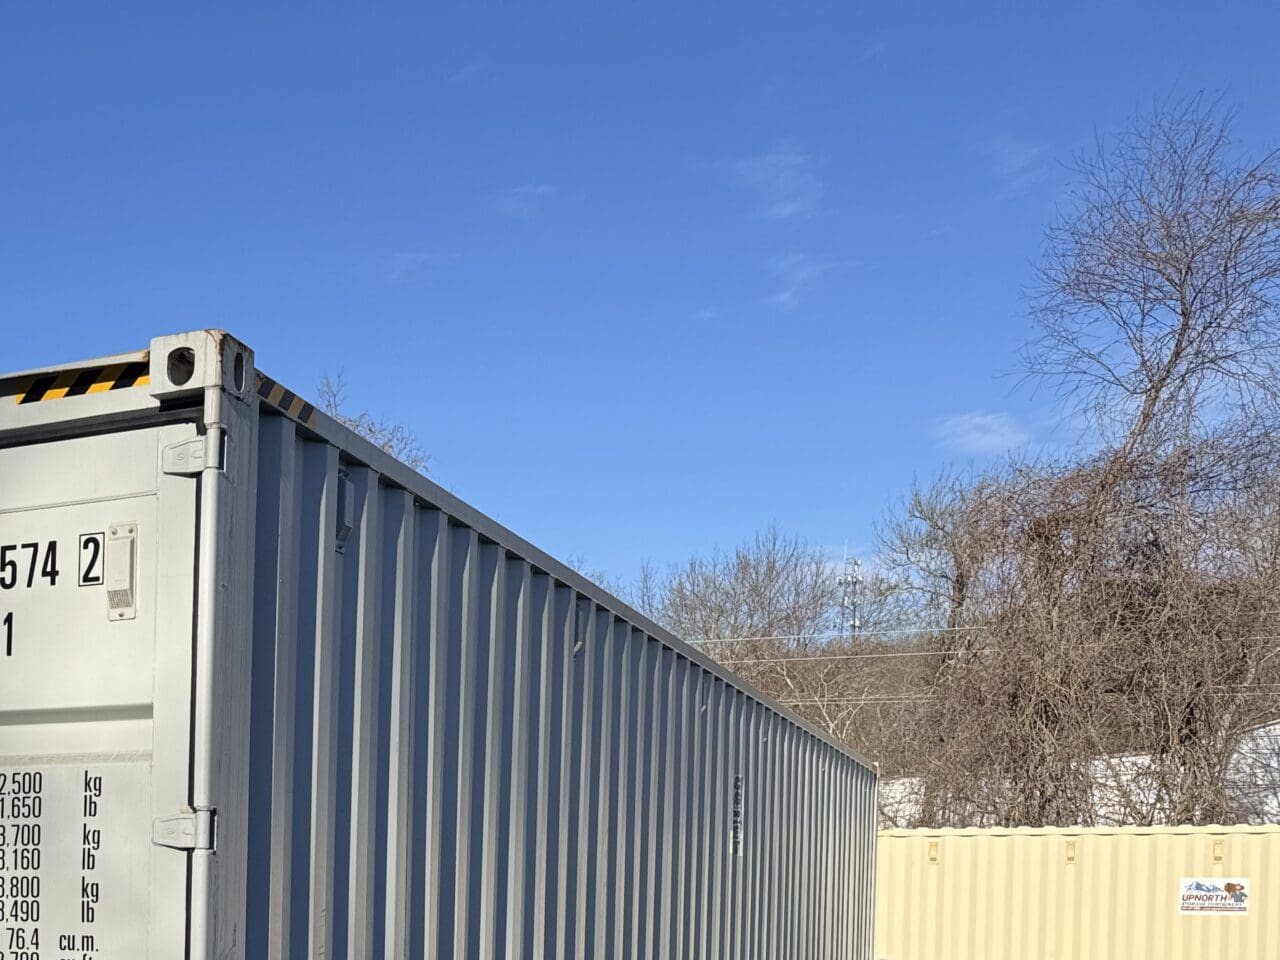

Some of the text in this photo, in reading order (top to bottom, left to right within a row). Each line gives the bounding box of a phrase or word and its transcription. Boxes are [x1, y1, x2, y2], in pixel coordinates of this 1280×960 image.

[82, 536, 101, 583] 2
[84, 770, 102, 797] kg
[83, 795, 97, 818] lb
[82, 823, 100, 850] kg
[82, 848, 95, 870] lb
[81, 876, 99, 903] kg
[81, 900, 94, 923] lb
[6, 928, 99, 952] 76.4 cu.m.
